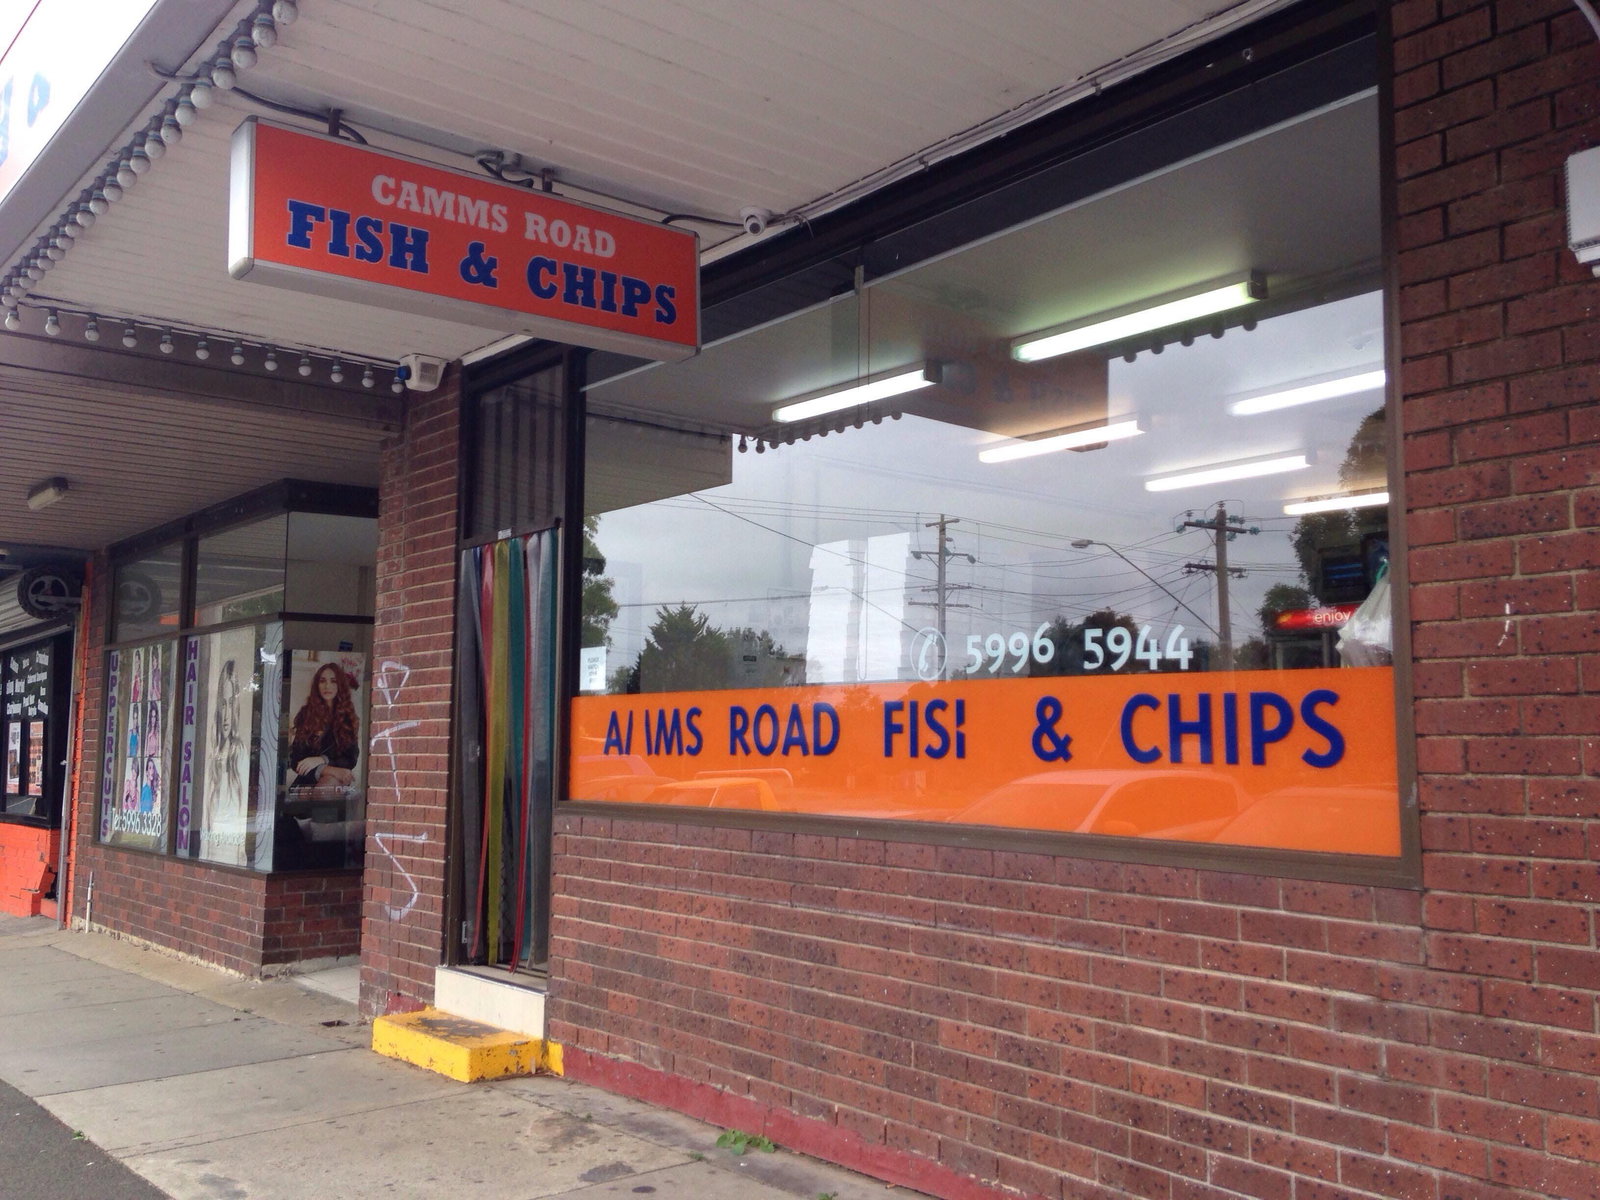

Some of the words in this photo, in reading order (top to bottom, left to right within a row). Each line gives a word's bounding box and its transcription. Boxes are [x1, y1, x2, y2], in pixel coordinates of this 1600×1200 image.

[371, 174, 508, 233] CAMMS
[524, 212, 616, 258] ROAD
[286, 199, 430, 274] FISH
[459, 241, 498, 289] &
[526, 256, 677, 325] CHIPS
[965, 621, 1055, 674] 5996
[1083, 623, 1194, 672] 5944
[1314, 608, 1351, 624] enjoy
[184, 641, 198, 725] HAIR
[101, 654, 118, 837] UPPERCUTS
[729, 702, 840, 756] ROAD
[1031, 695, 1073, 762] &
[1120, 689, 1346, 768] CHIPS
[141, 811, 162, 837] 3328
[177, 741, 193, 850] SALON
